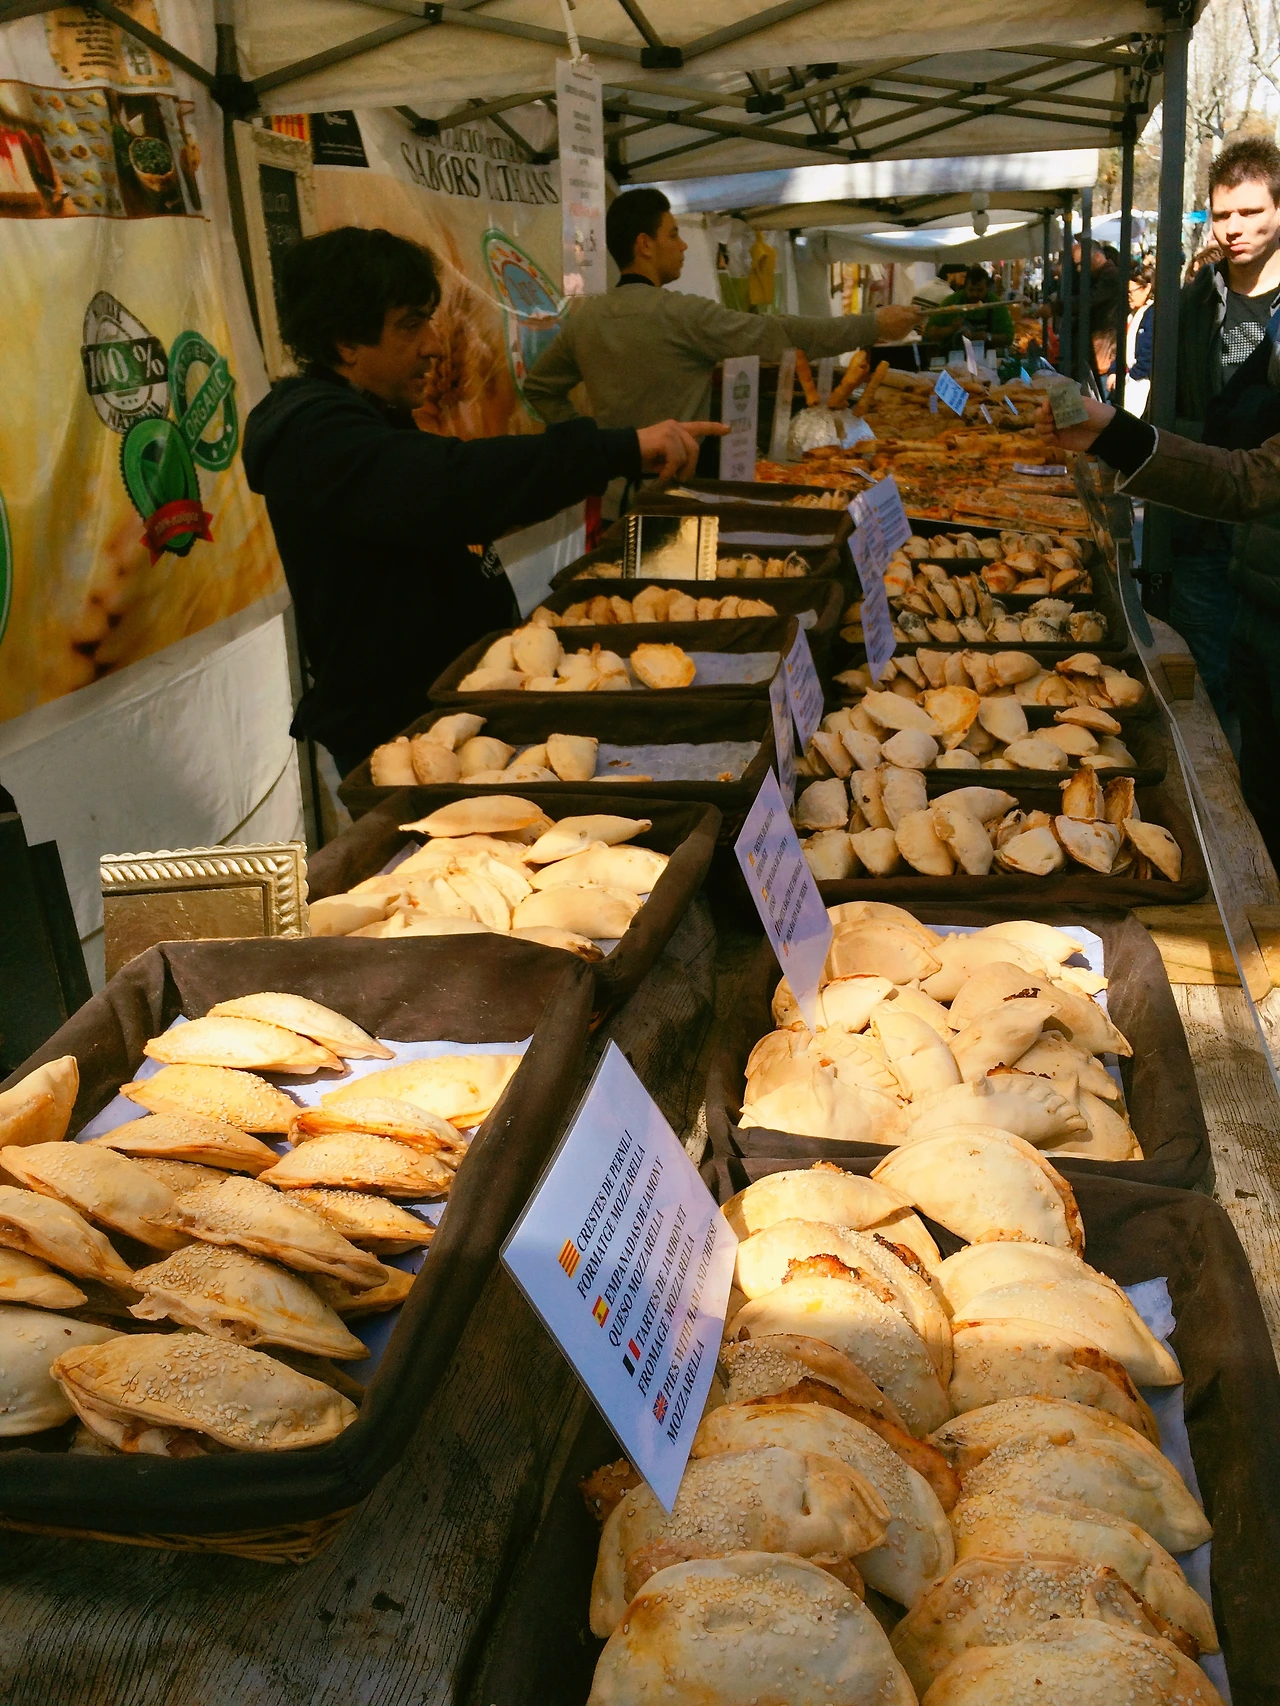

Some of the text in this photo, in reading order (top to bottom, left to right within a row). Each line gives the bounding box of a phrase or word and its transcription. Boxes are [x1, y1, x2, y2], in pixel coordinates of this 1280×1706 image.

[400, 142, 480, 198] SABORS
[184, 367, 228, 440] ORGANIC
[577, 1129, 632, 1251] CRESTES DE PERNIL I
[577, 1145, 645, 1299] FORMATGE MOZZARELLA
[605, 1156, 663, 1306] EMPANADAS DE JAMON Y
[609, 1210, 663, 1346] QUESO MOZZARELLA
[635, 1204, 686, 1347] TARTES DE JAMBON ET
[638, 1235, 694, 1397] FROMAGE MOZZARELLA
[663, 1219, 717, 1399] PIES WITH HAM AND CHEESE
[667, 1340, 704, 1444] MOZZARELLA
